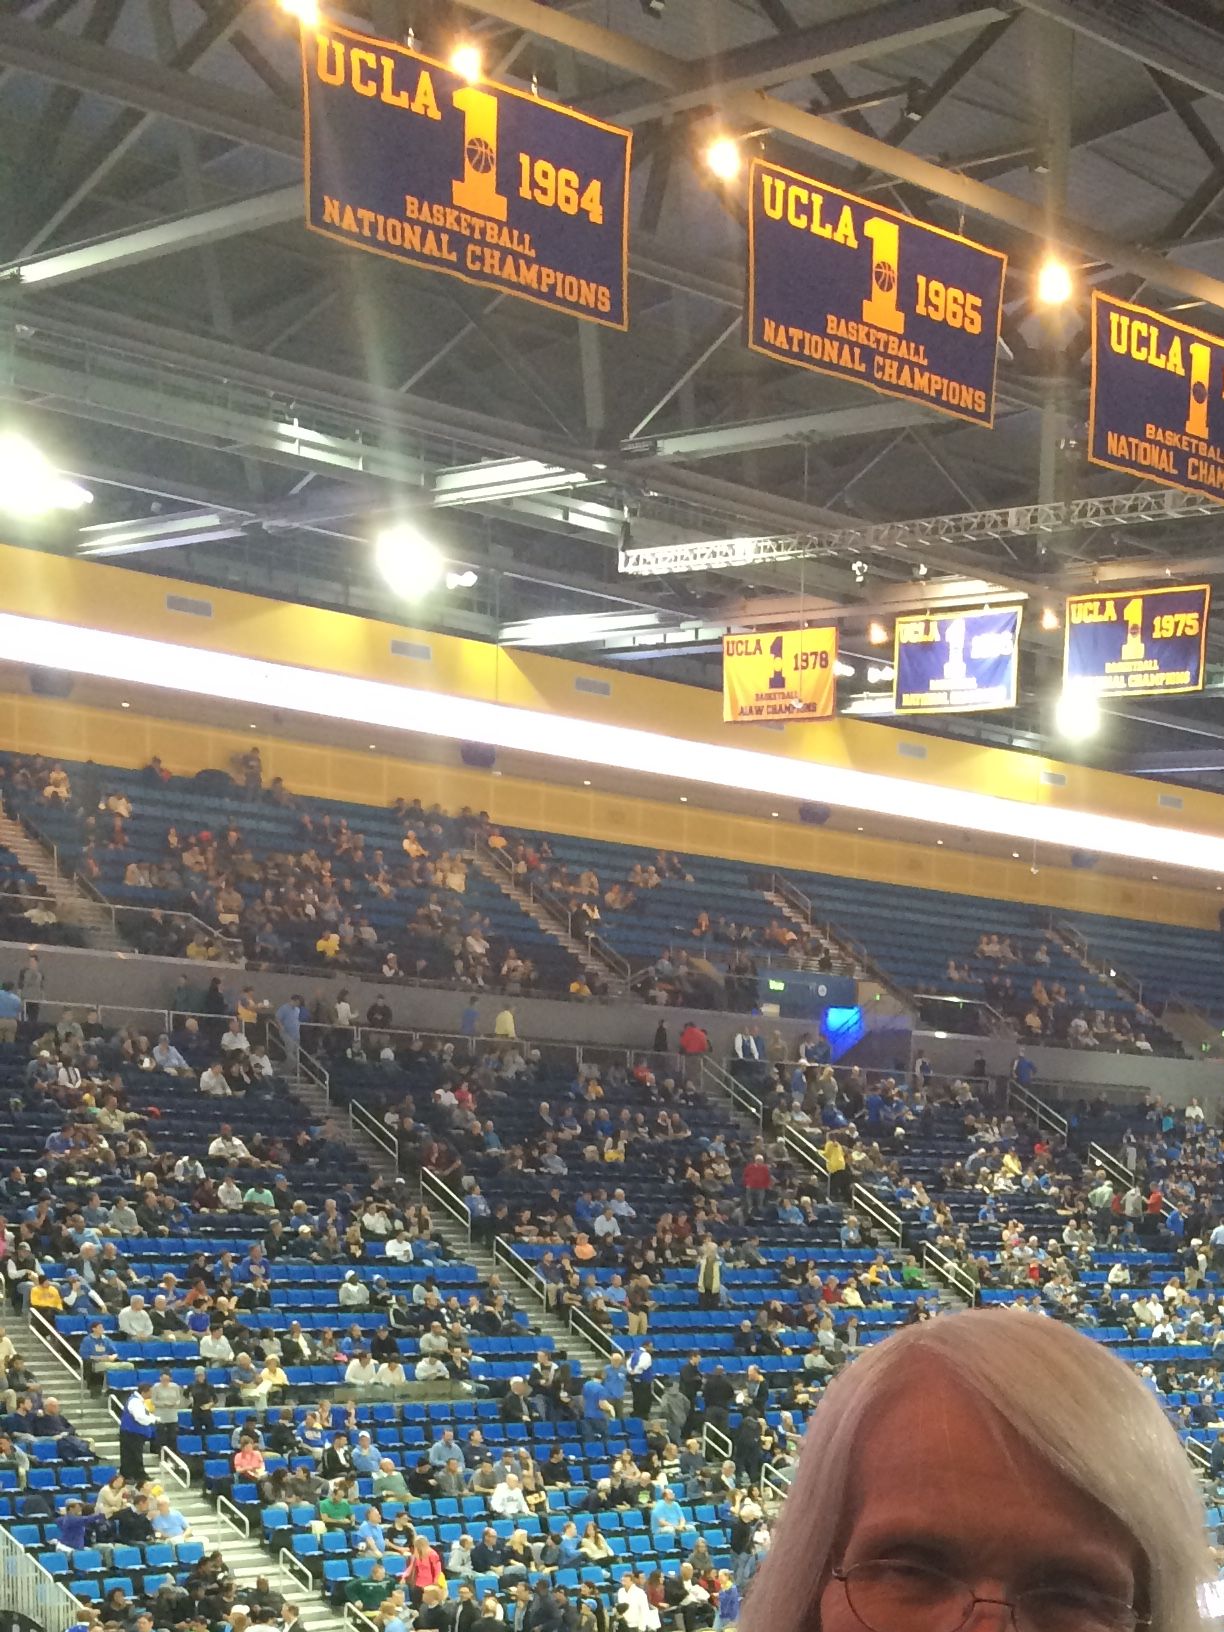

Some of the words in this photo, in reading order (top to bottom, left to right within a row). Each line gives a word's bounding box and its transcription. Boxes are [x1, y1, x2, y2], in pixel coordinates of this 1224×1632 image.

[317, 35, 441, 120] UCLA
[519, 153, 603, 224] 1964
[762, 174, 858, 249] UCLA
[323, 196, 457, 261] NATIONAL
[466, 245, 611, 313] CHAMPIONS
[405, 195, 536, 257] BASKETBALL
[916, 275, 982, 334] 1965
[764, 318, 866, 373] NATIONAL
[874, 356, 986, 413] CHAMPIONS
[827, 315, 928, 366] BASKETBALL
[1110, 312, 1185, 376] UCLA
[1107, 431, 1178, 474] NATIONAL
[1071, 600, 1117, 624] UCLA
[1152, 612, 1200, 638] 1975
[727, 639, 762, 656] UCLA
[794, 650, 828, 671] 1978
